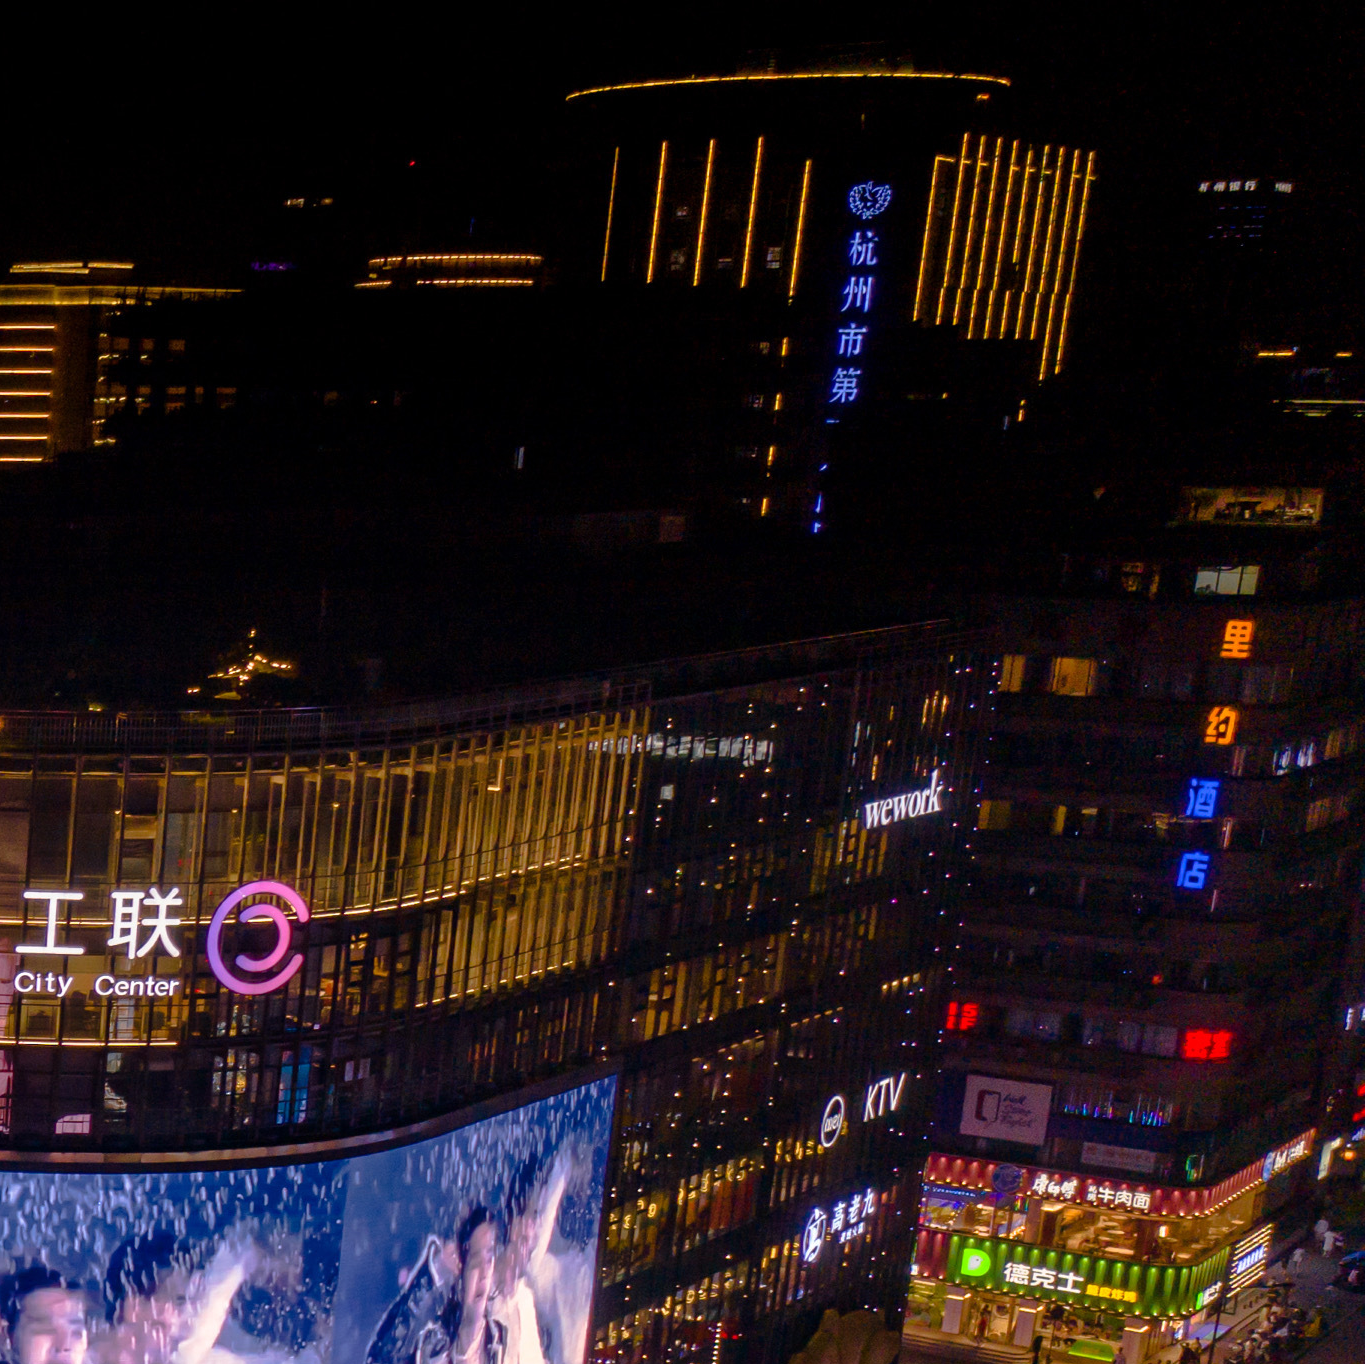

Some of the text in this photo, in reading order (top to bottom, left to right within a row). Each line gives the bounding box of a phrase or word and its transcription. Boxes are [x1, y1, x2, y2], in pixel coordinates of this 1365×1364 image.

[863, 769, 945, 830] wework
[14, 887, 184, 960] 工联
[13, 971, 180, 997] City Center
[863, 1072, 907, 1123] KTV
[830, 1187, 876, 1234] 高老九
[1097, 1185, 1152, 1210] 牛肉面
[1003, 1262, 1085, 1295] 德克士
